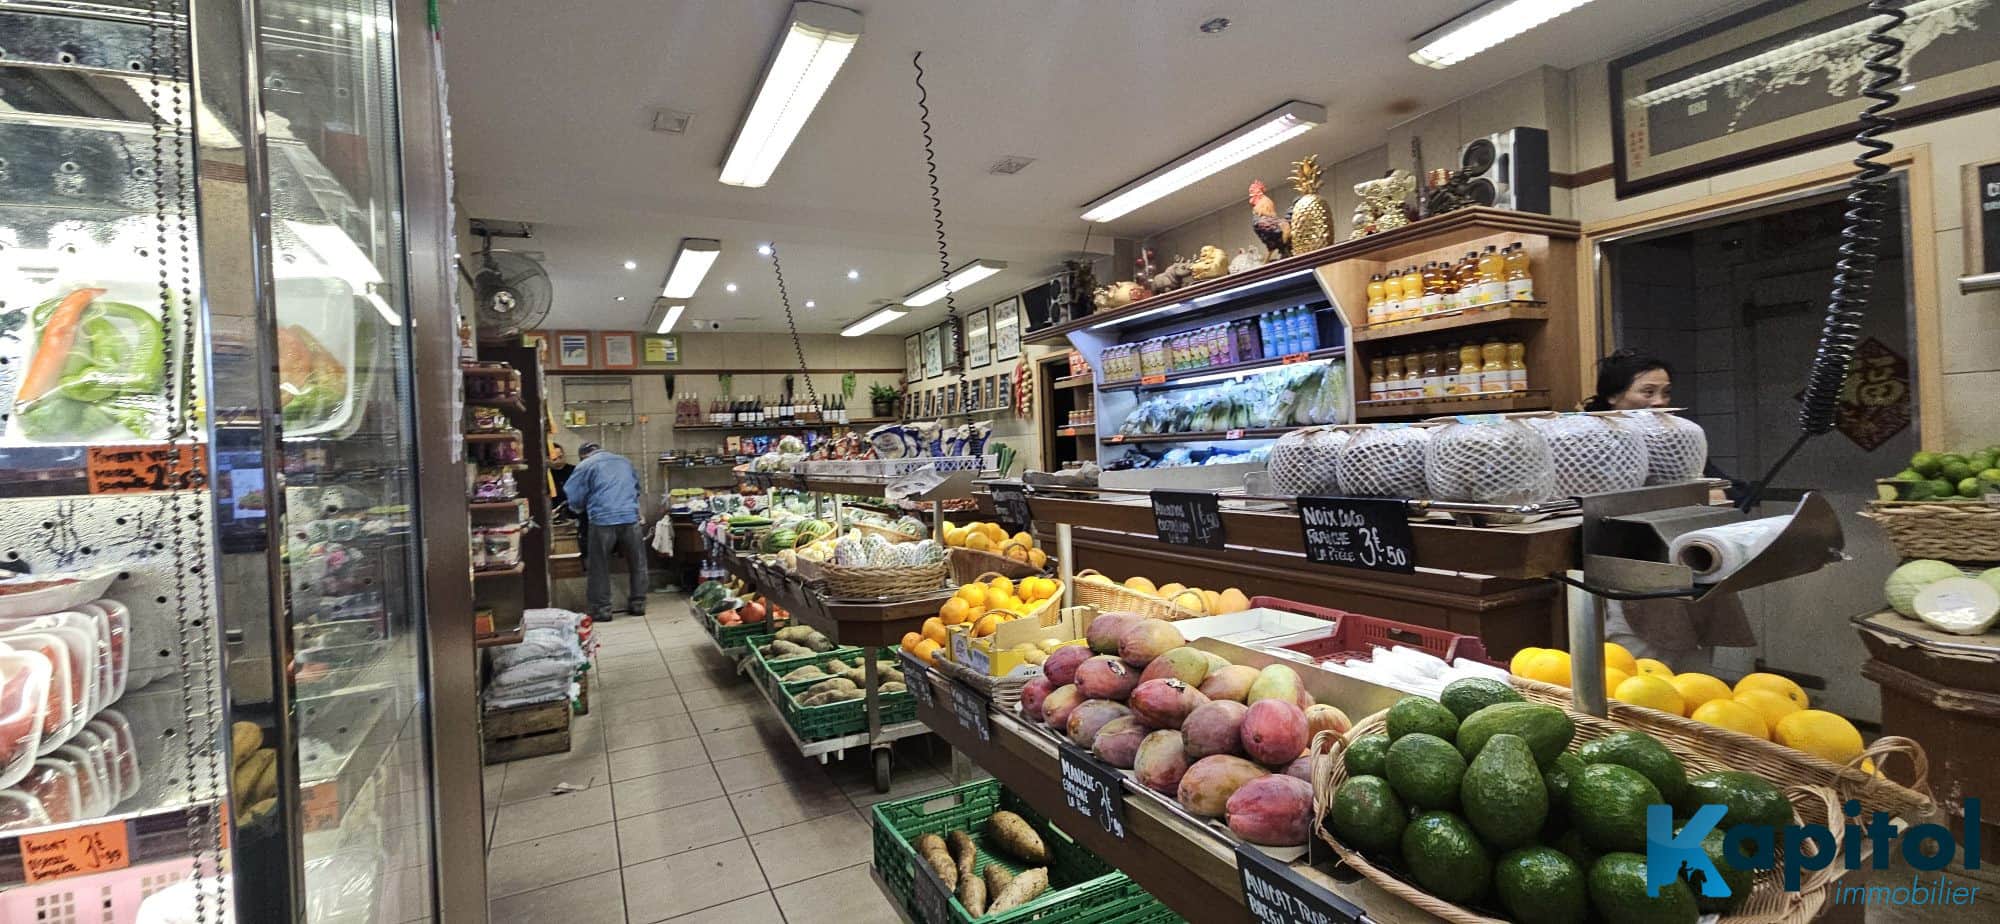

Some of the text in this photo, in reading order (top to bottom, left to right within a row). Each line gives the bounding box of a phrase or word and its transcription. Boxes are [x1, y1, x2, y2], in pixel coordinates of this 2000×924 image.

[1302, 506, 1365, 528] NOIX COCO
[1061, 757, 1096, 792] MANGUE
